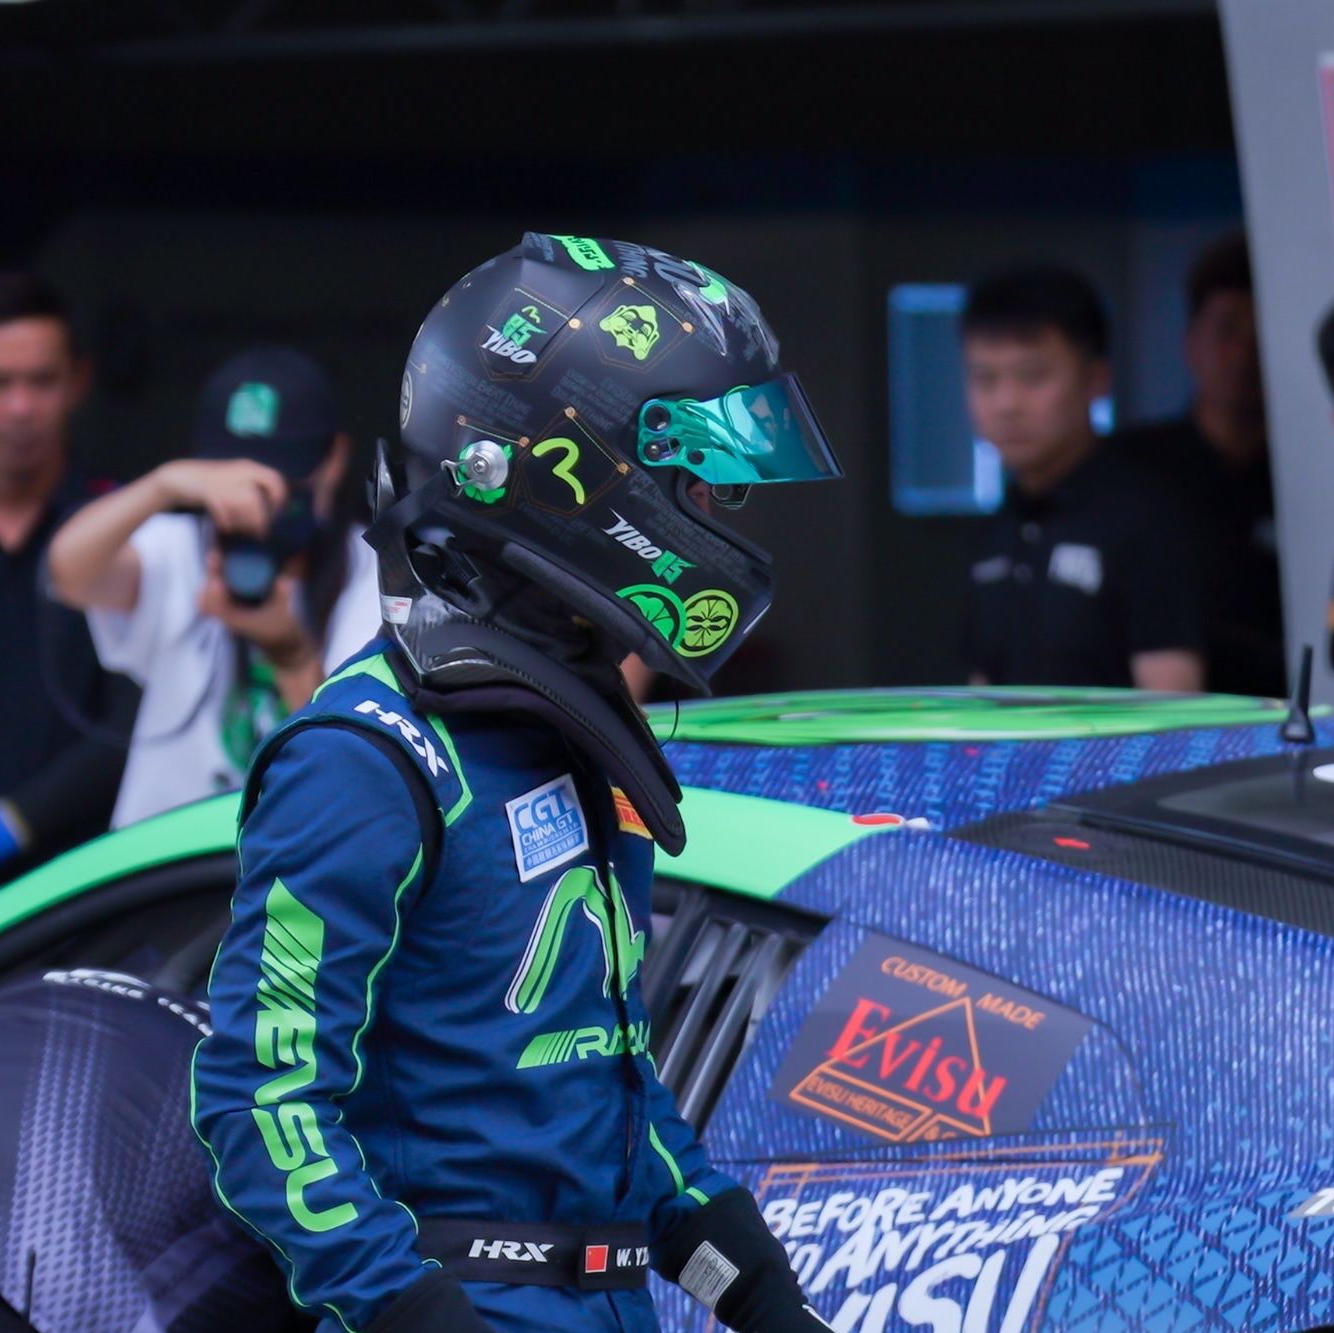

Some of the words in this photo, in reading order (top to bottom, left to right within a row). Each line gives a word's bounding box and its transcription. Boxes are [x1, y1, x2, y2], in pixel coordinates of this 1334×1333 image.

[601, 507, 662, 560] YIBO
[354, 700, 450, 777] HRX
[514, 786, 567, 834] CGT
[880, 956, 967, 997] CUSTOM
[976, 993, 1046, 1030] MADE
[827, 997, 1008, 1119] Evisu
[761, 1187, 931, 1239] BEFORE
[927, 1166, 1125, 1221] ANYONE
[468, 1238, 554, 1263] HRX
[810, 1205, 1100, 1294] ANYTHING
